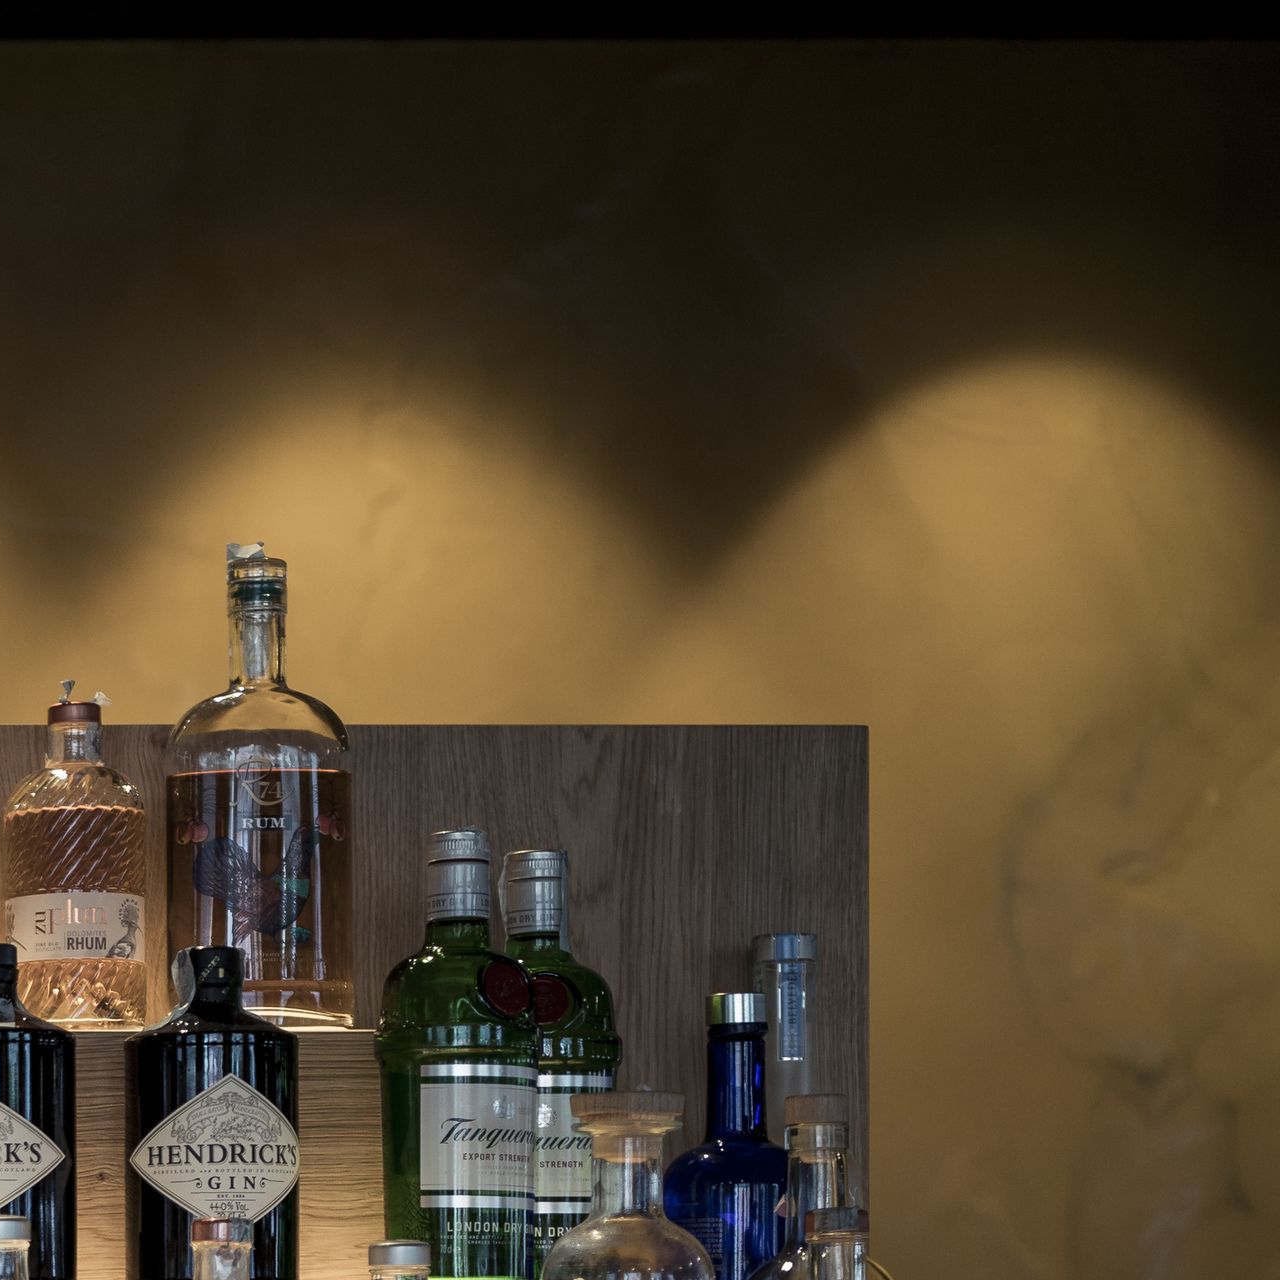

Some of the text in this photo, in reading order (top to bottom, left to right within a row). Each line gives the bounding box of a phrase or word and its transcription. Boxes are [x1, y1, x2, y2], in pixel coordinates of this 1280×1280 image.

[241, 817, 287, 829] RUM
[66, 929, 108, 937] DOLOMITES
[66, 936, 107, 951] RHUM
[146, 1142, 298, 1167] HENDRICK'S
[462, 1152, 531, 1164] EXPORT STRENGTH
[539, 1160, 584, 1169] STRENGTH
[207, 1175, 258, 1191] GIN
[446, 1221, 522, 1234] LONDON DRY
[547, 1226, 573, 1238] DRY
